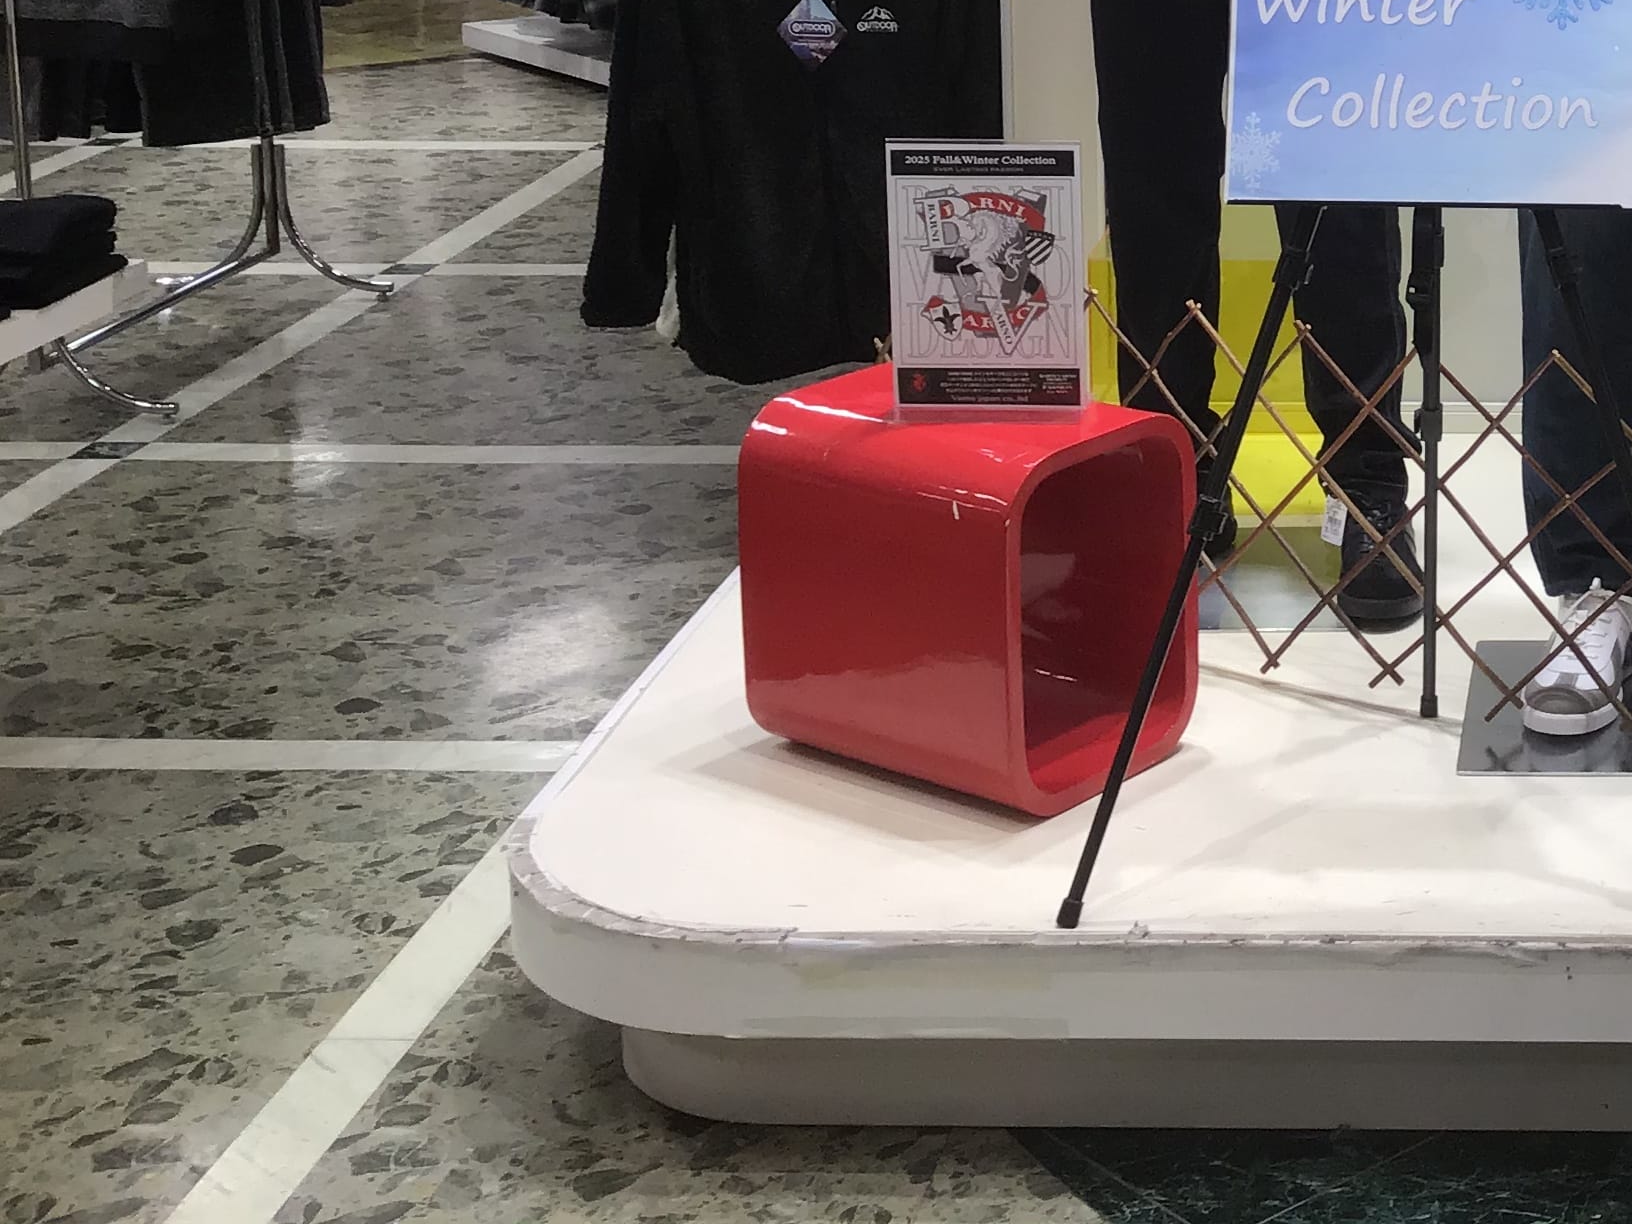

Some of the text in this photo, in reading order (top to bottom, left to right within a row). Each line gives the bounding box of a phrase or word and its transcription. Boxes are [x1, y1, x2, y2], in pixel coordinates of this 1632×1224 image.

[1286, 73, 1599, 130] Collection
[904, 155, 1057, 166] 2025 Fall&Winter Collection
